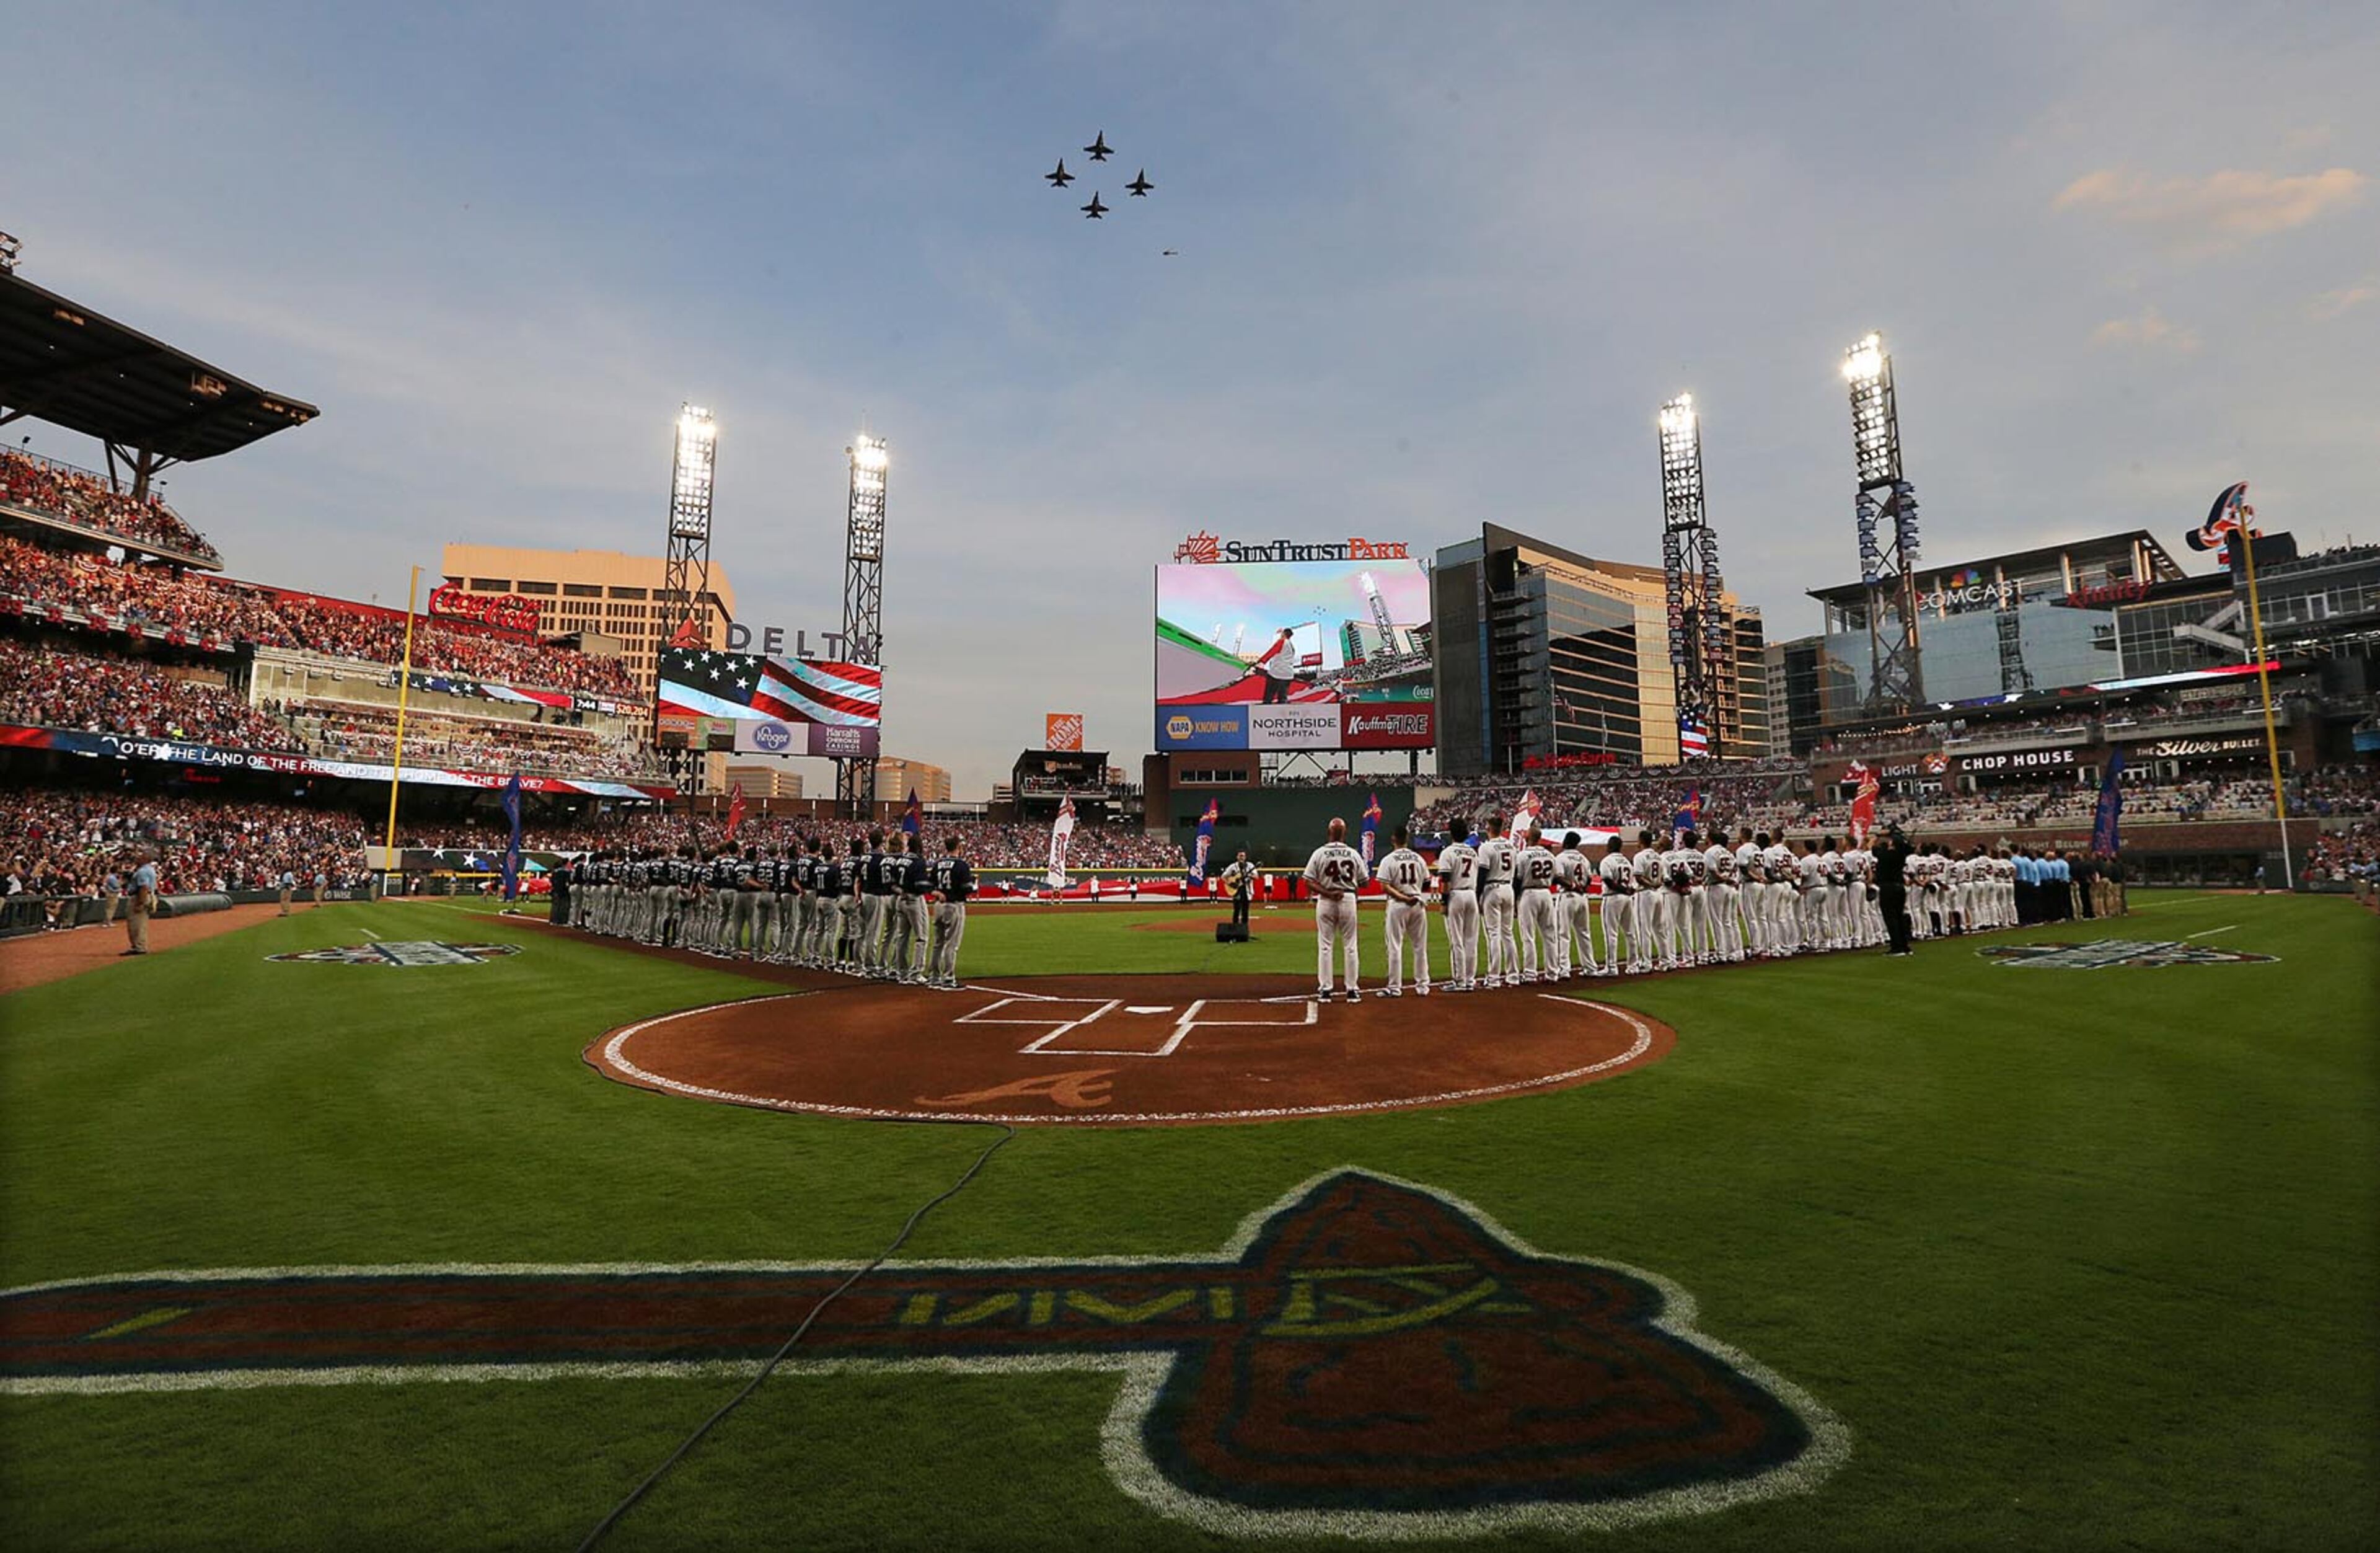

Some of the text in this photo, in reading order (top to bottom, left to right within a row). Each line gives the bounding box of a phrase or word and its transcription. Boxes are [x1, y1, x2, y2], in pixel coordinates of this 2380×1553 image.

[1347, 538, 1409, 560] PARK
[726, 622, 875, 663] DELTA
[576, 699, 596, 709] 7:44
[1046, 714, 1082, 749] HOME
[1170, 722, 1190, 733] NAPA
[1195, 721, 1239, 733] KNOW HOW
[1253, 717, 1337, 728] NORTHSIDE
[1348, 714, 1429, 735] Kauffman TIRE
[757, 726, 788, 749] Kroger
[1267, 730, 1321, 738] HOSPITAL
[2136, 747, 2156, 756] THE
[2156, 740, 2221, 757] Silver
[201, 749, 244, 765] LAND
[247, 754, 267, 767] OF
[270, 757, 298, 771] THE
[300, 760, 335, 774] FREE
[470, 774, 495, 786] THE
[1881, 764, 1918, 777] LIGHT
[1962, 750, 2074, 771] CHOP HOUSE
[1324, 860, 1355, 883] 43
[1460, 857, 1472, 878] 7
[1500, 851, 1511, 872] 5
[1530, 859, 1554, 880] 22
[1651, 861, 1660, 878] 8
[757, 868, 774, 883] 22
[937, 869, 952, 890] 14
[1399, 863, 1417, 885] 11
[1573, 863, 1583, 882] 4
[1618, 866, 1631, 884] 13
